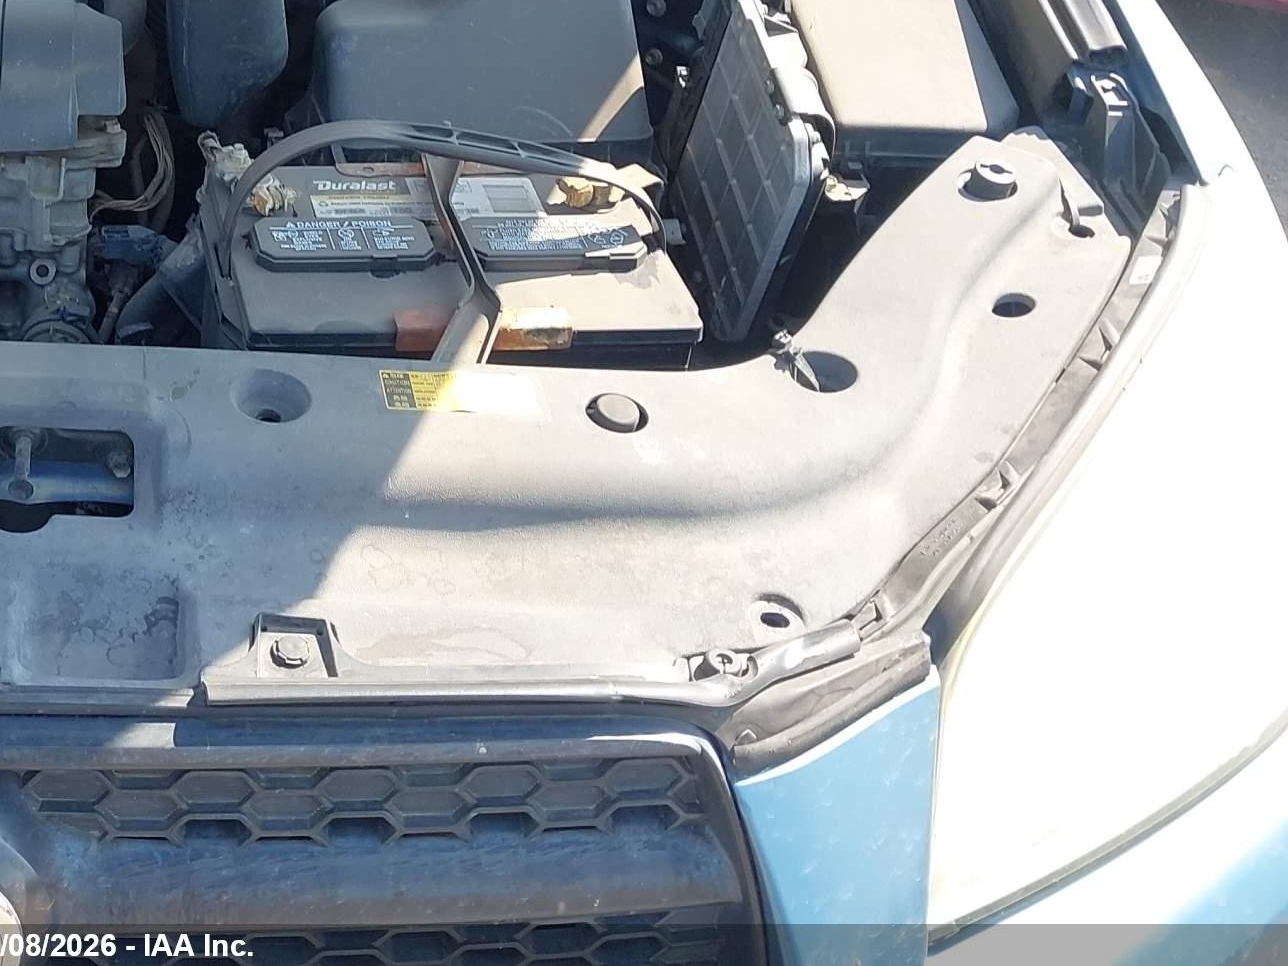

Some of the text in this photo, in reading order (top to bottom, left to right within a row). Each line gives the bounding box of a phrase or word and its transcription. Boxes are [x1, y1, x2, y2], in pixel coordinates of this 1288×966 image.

[313, 180, 397, 191] Duralast
[296, 221, 341, 229] DANGER
[351, 220, 392, 228] POISON
